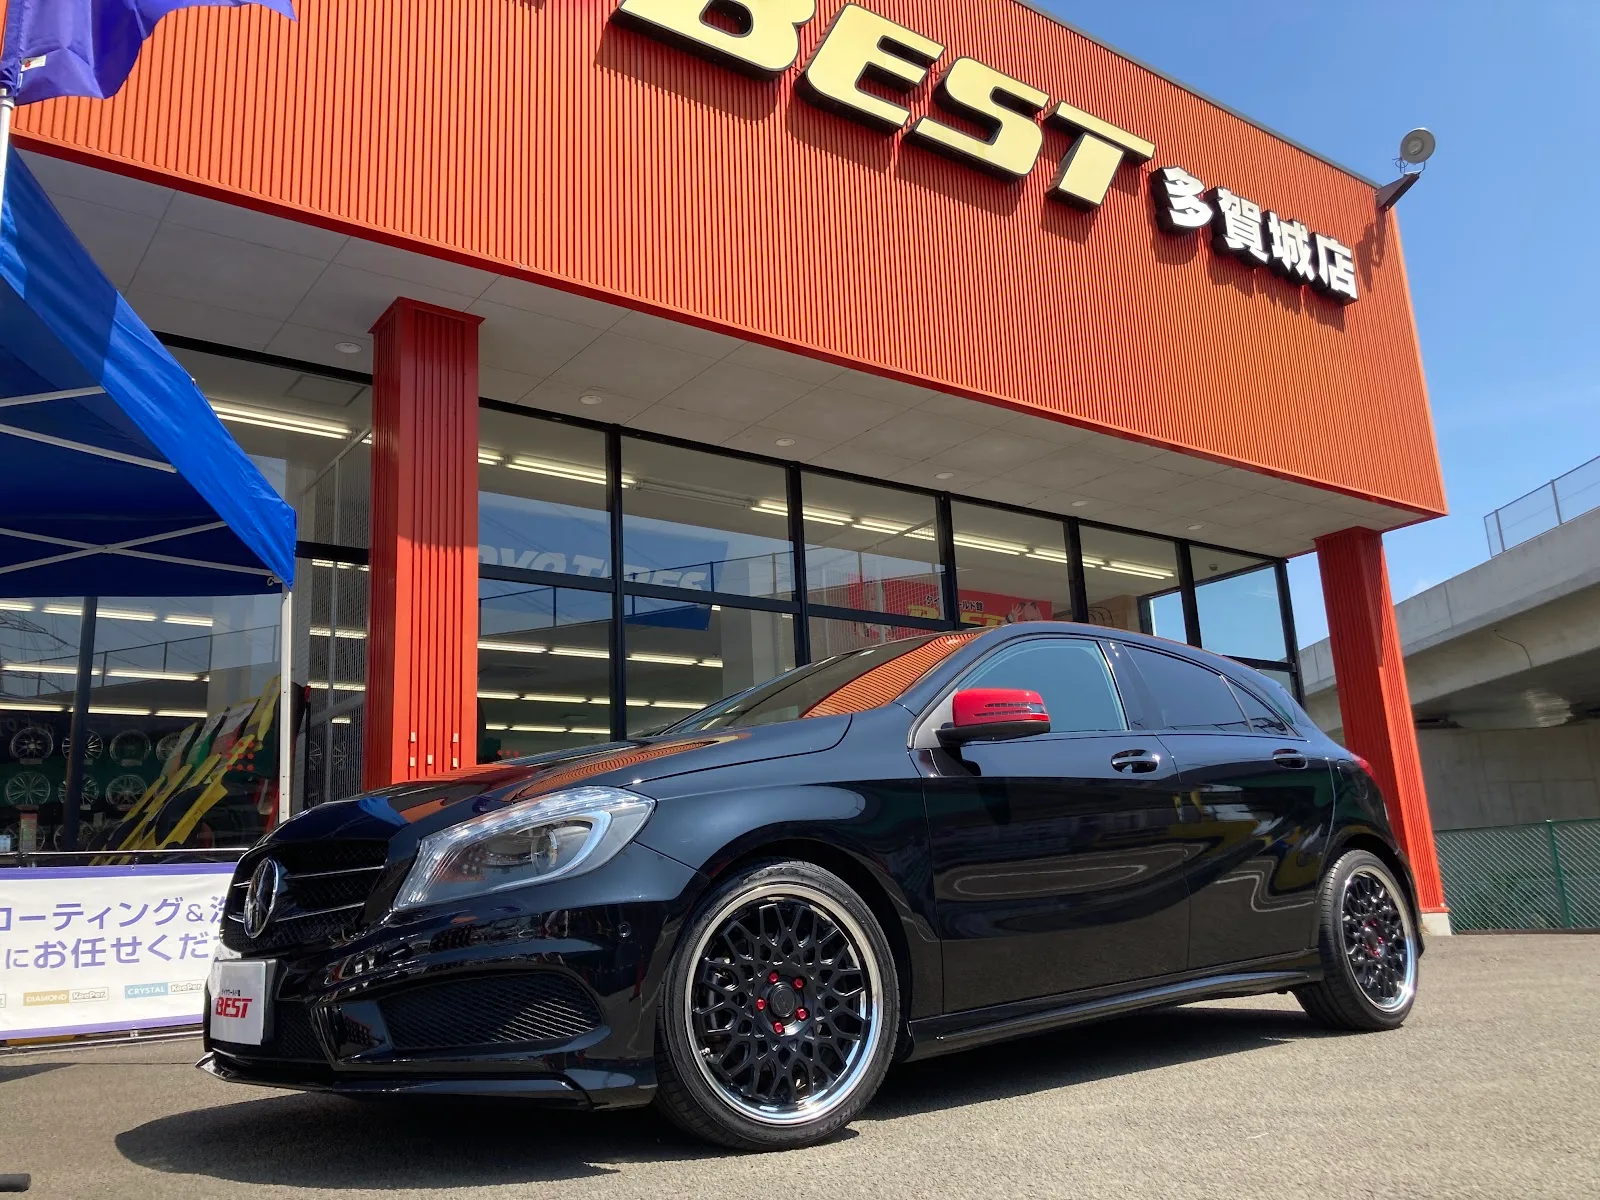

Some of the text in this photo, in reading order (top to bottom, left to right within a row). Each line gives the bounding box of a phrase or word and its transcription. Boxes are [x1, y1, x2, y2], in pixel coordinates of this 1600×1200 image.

[1160, 165, 1358, 301] 多賀城店
[5, 931, 220, 969] にお任せくだ
[26, 993, 67, 1003] DIAMOND
[127, 985, 165, 995] CRYSTAL
[215, 997, 252, 1018] BEST
